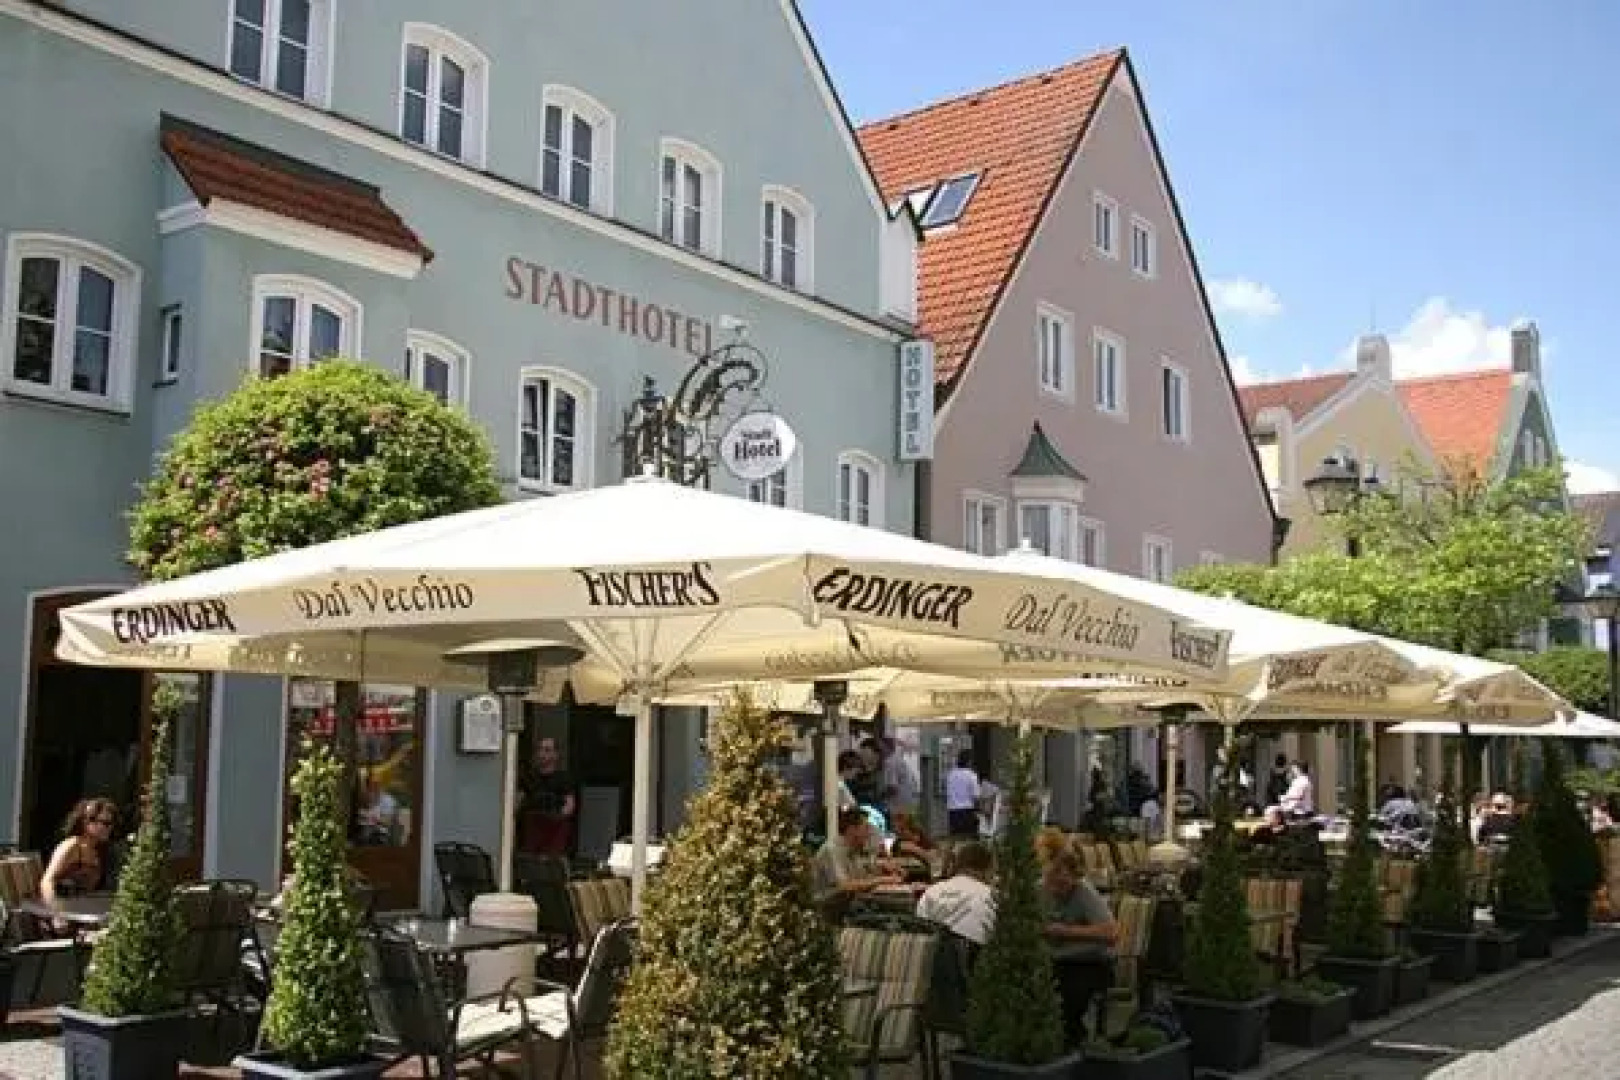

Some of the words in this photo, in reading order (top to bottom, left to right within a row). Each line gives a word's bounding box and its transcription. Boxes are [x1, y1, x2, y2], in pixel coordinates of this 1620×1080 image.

[505, 256, 712, 357] STADTHOTEL
[905, 345, 921, 454] HOTEL
[733, 438, 783, 460] Hotel
[295, 579, 352, 619] Dal
[354, 574, 474, 613] Vecchio
[574, 561, 720, 607] FISCHER'S
[813, 568, 973, 629] ERDINGER
[112, 599, 236, 644] ERDINGER
[1005, 593, 1067, 636] Dal
